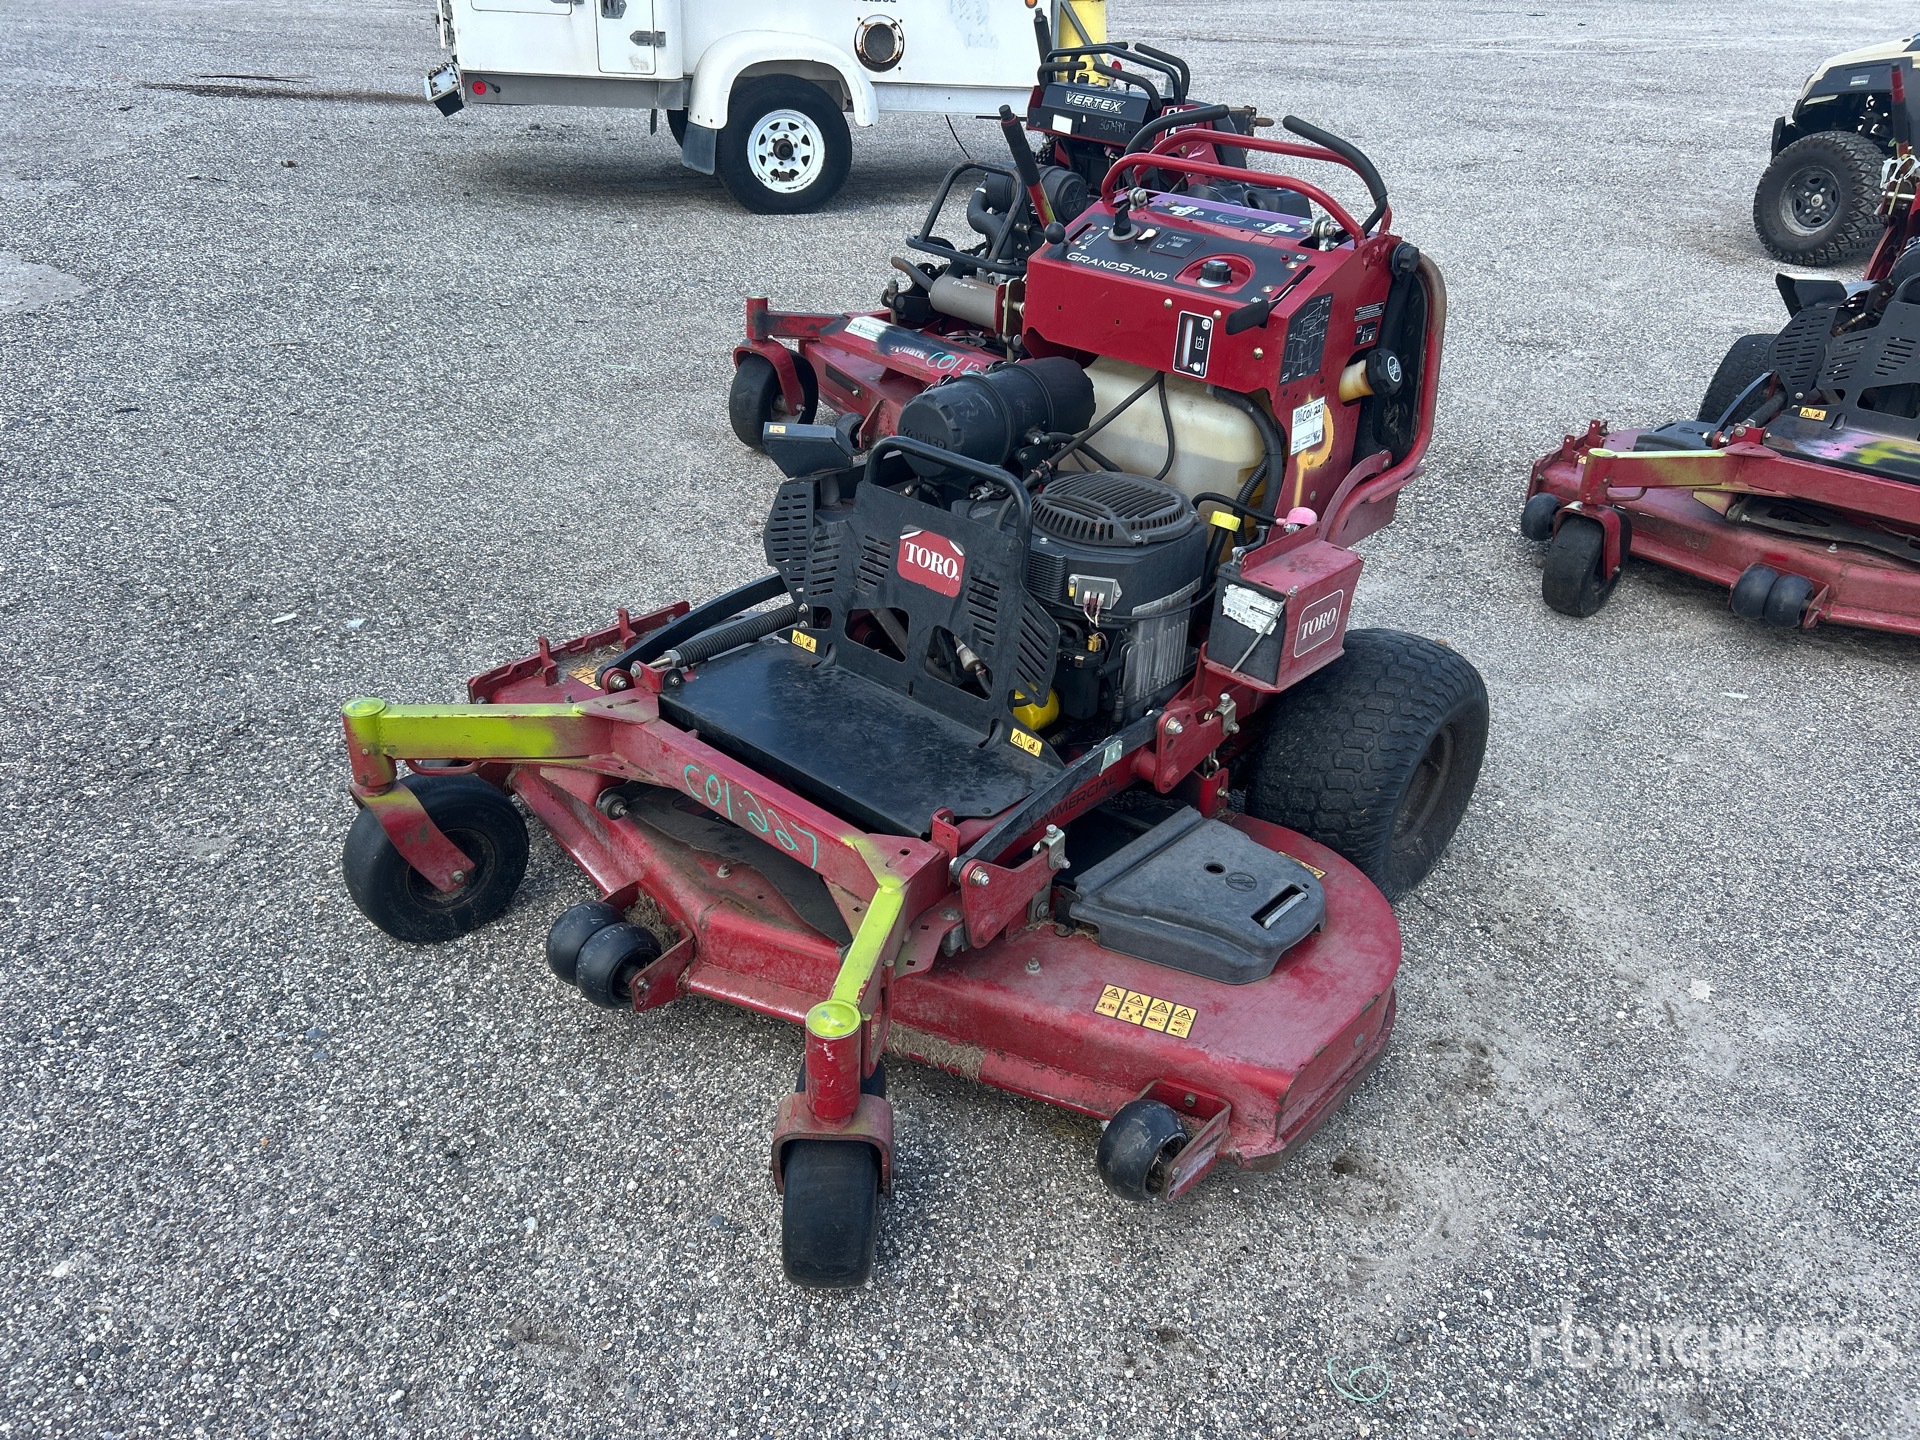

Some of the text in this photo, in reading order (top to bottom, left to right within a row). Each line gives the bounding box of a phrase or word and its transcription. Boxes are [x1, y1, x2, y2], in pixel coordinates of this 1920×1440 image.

[1065, 91, 1126, 114] VERTEX
[904, 541, 960, 581] TORO
[1300, 606, 1338, 641] TORO
